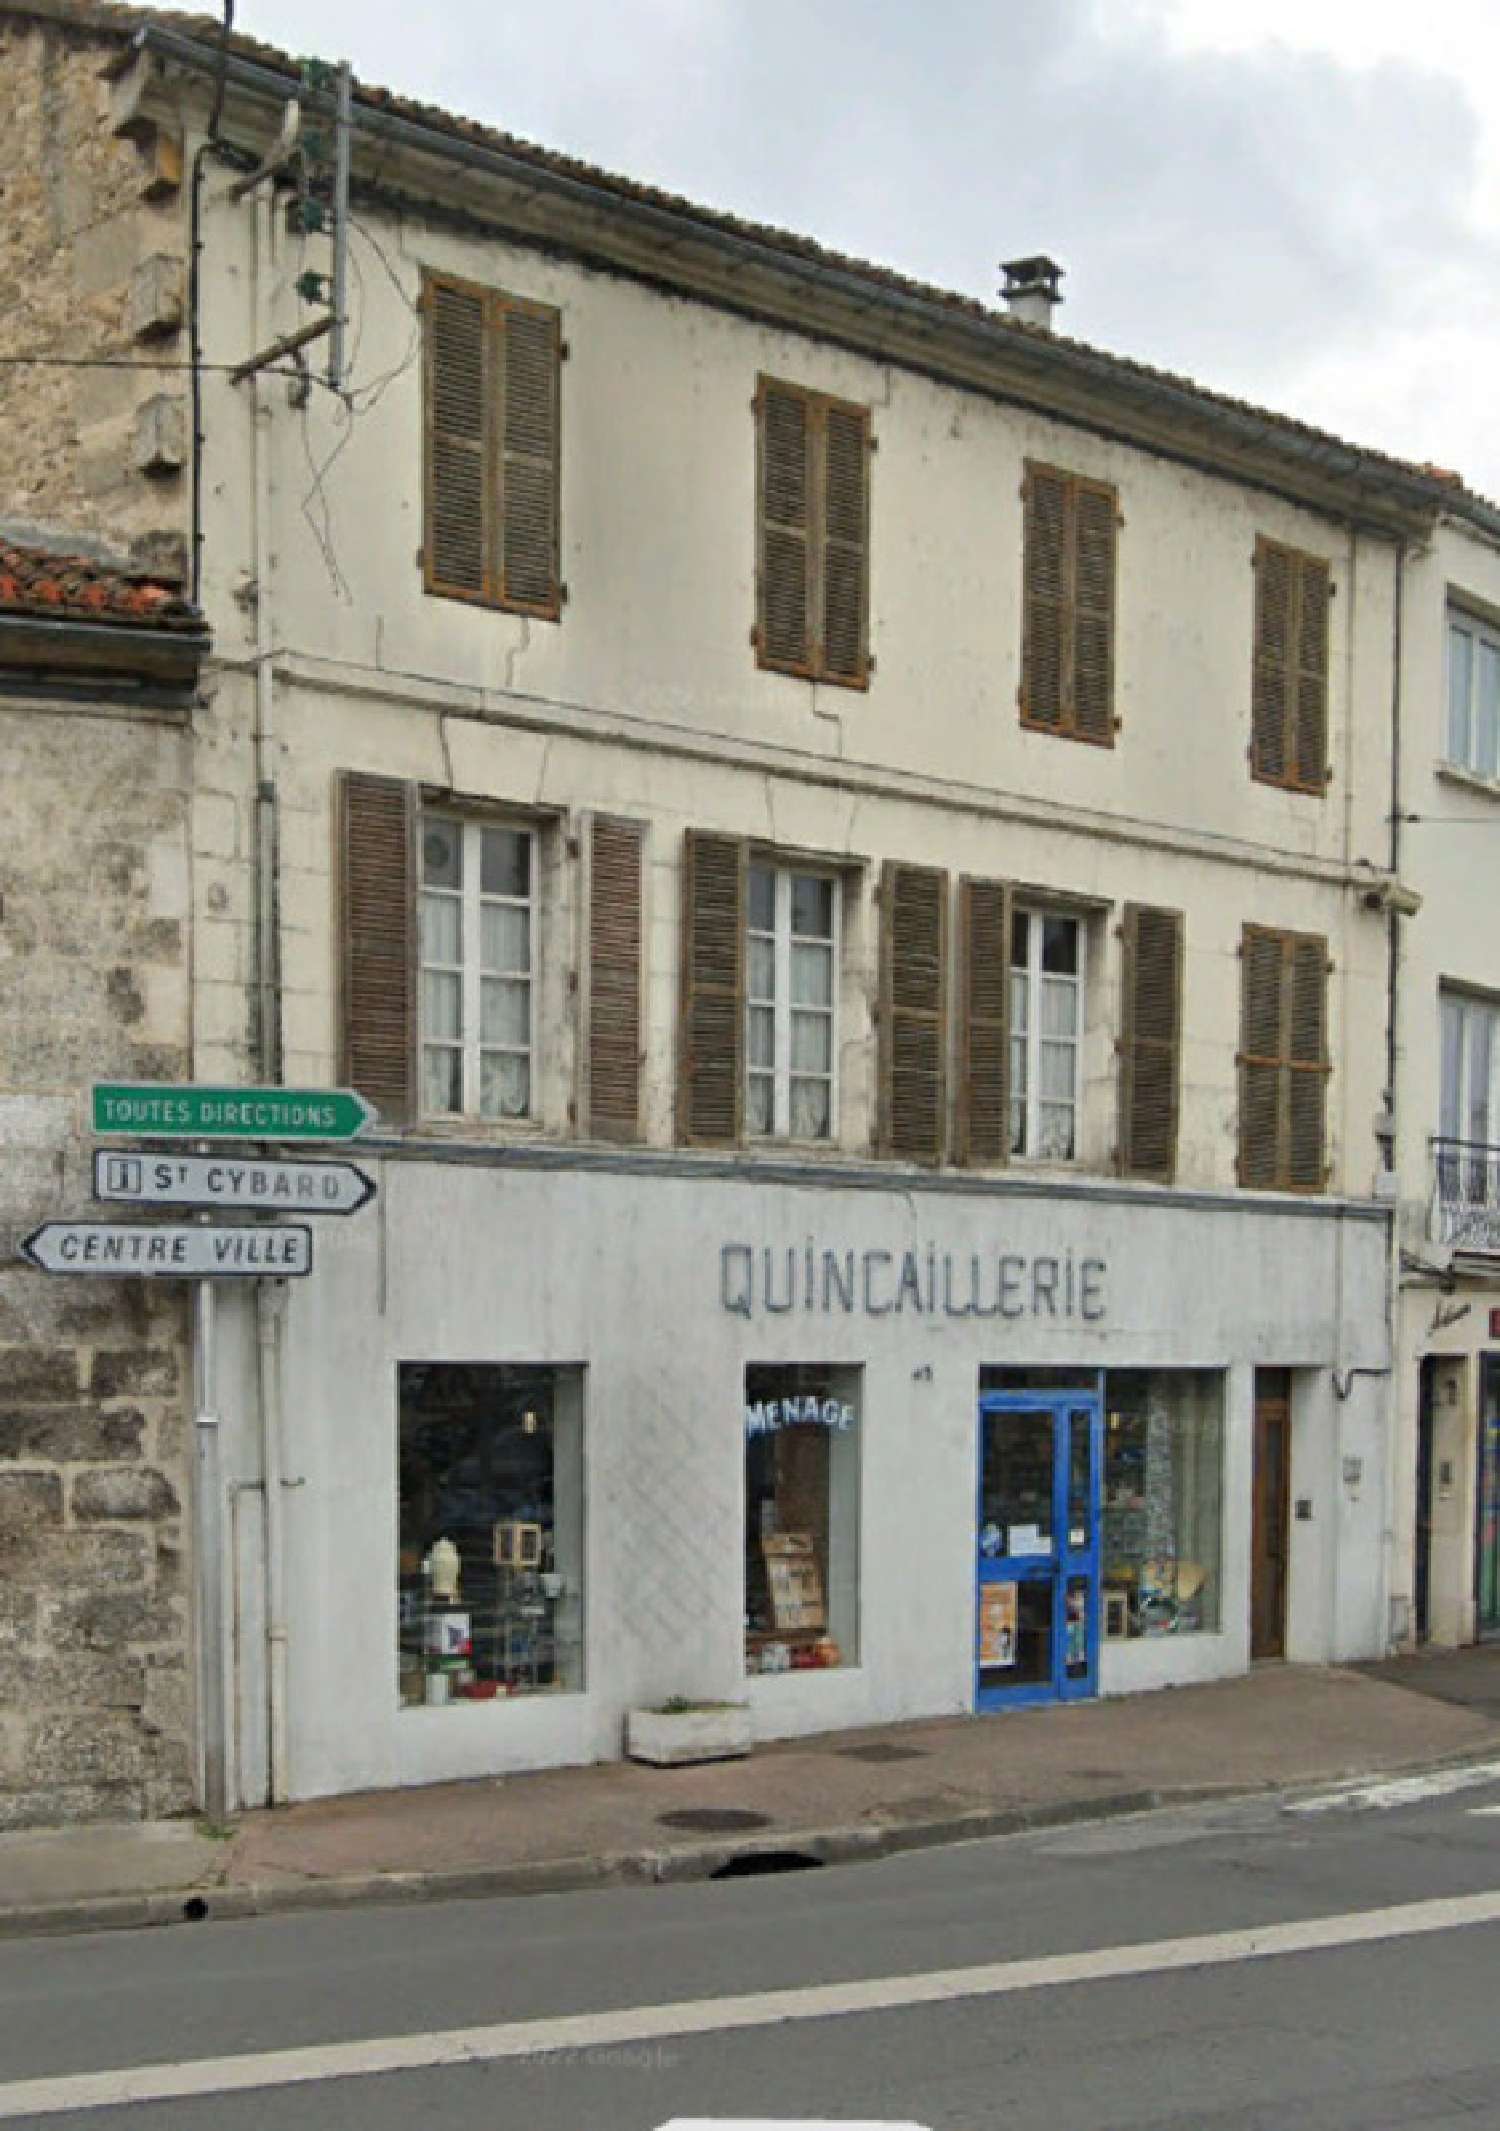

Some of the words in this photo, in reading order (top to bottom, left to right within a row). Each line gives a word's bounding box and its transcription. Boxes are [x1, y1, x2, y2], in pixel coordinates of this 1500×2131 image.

[104, 1099, 192, 1123] TOUTES
[201, 1102, 337, 1127] DIRECTIONS
[207, 1167, 341, 1200] CYBARD
[59, 1234, 189, 1262] CENTRE
[214, 1236, 298, 1264] VILLE
[744, 1396, 855, 1438] MENAGE
